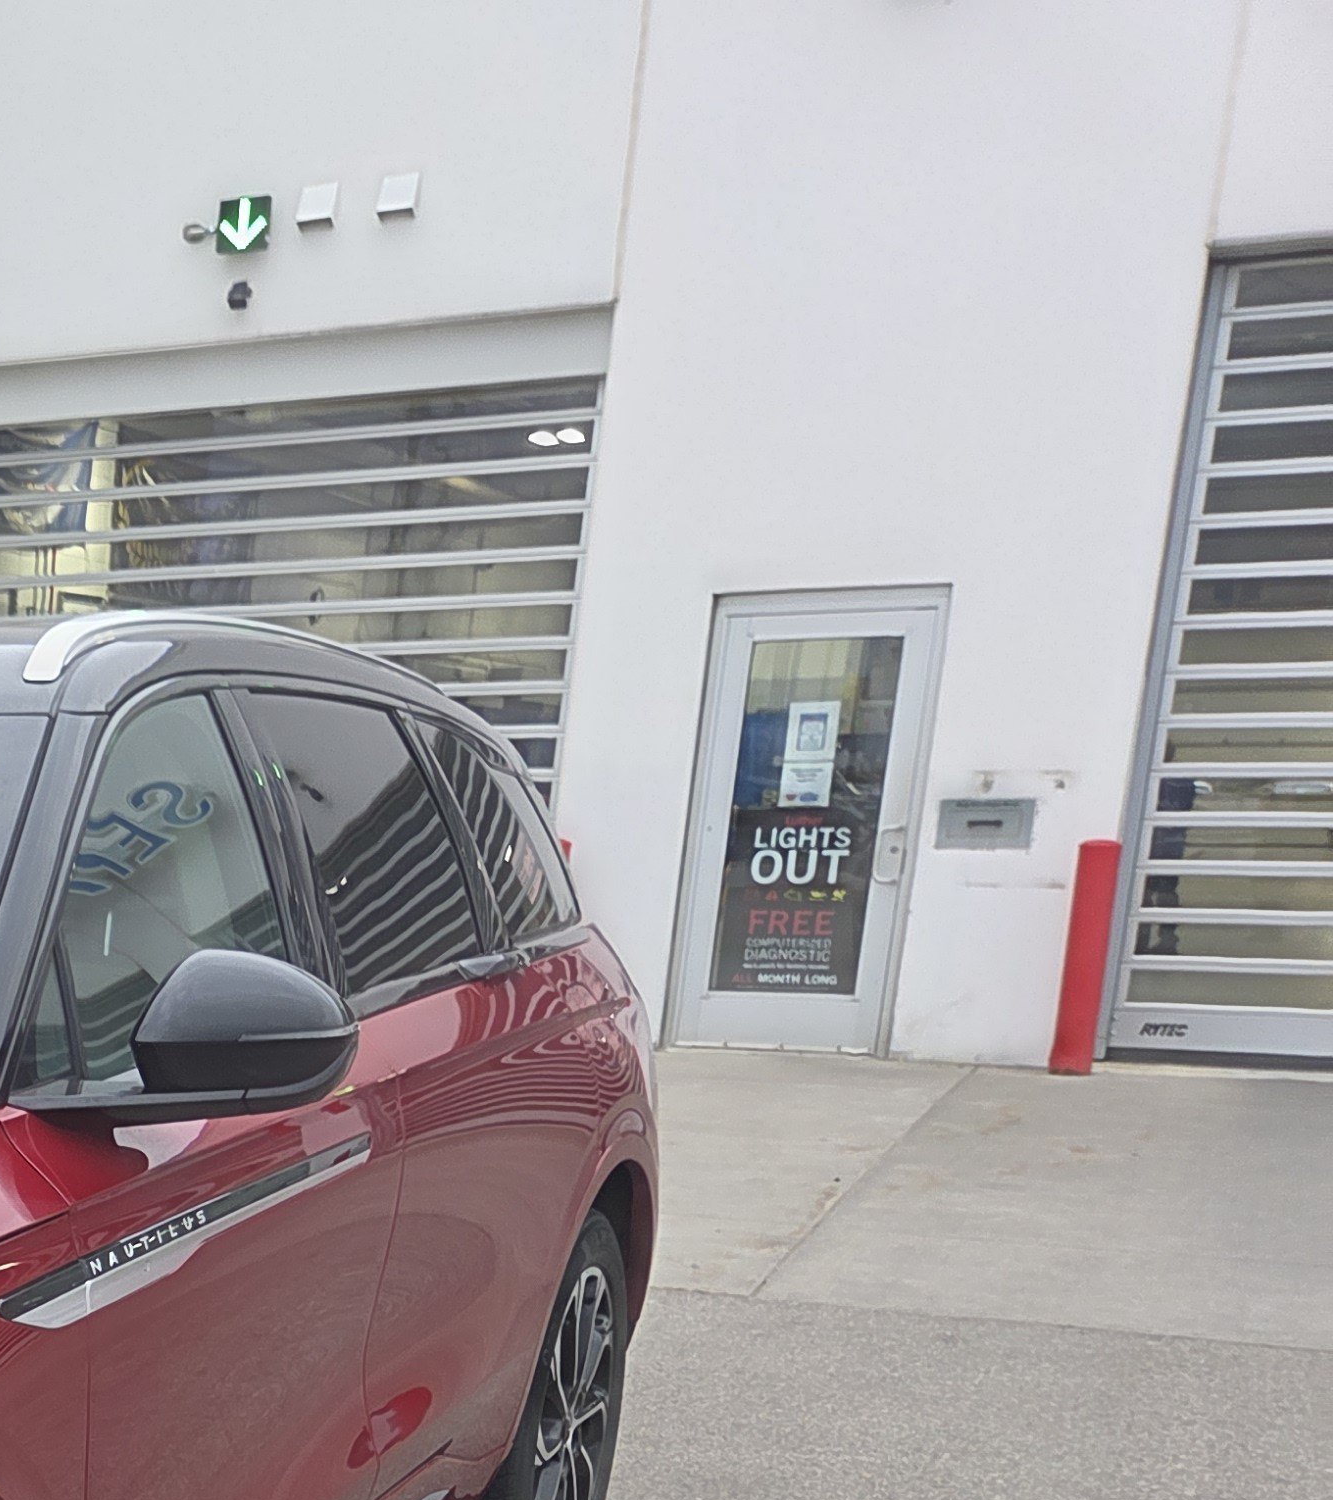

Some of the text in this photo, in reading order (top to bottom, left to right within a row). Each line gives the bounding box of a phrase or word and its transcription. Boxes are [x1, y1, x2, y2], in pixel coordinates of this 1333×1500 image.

[754, 826, 852, 848] LIGHTS
[751, 849, 850, 884] OUT
[748, 909, 835, 935] FREE
[744, 949, 830, 962] DIAGNOSTIC
[758, 973, 801, 984] MONTH
[805, 974, 837, 985] LONG
[1139, 1023, 1188, 1037] RYTEC
[90, 1210, 206, 1275] NAUTILUS
